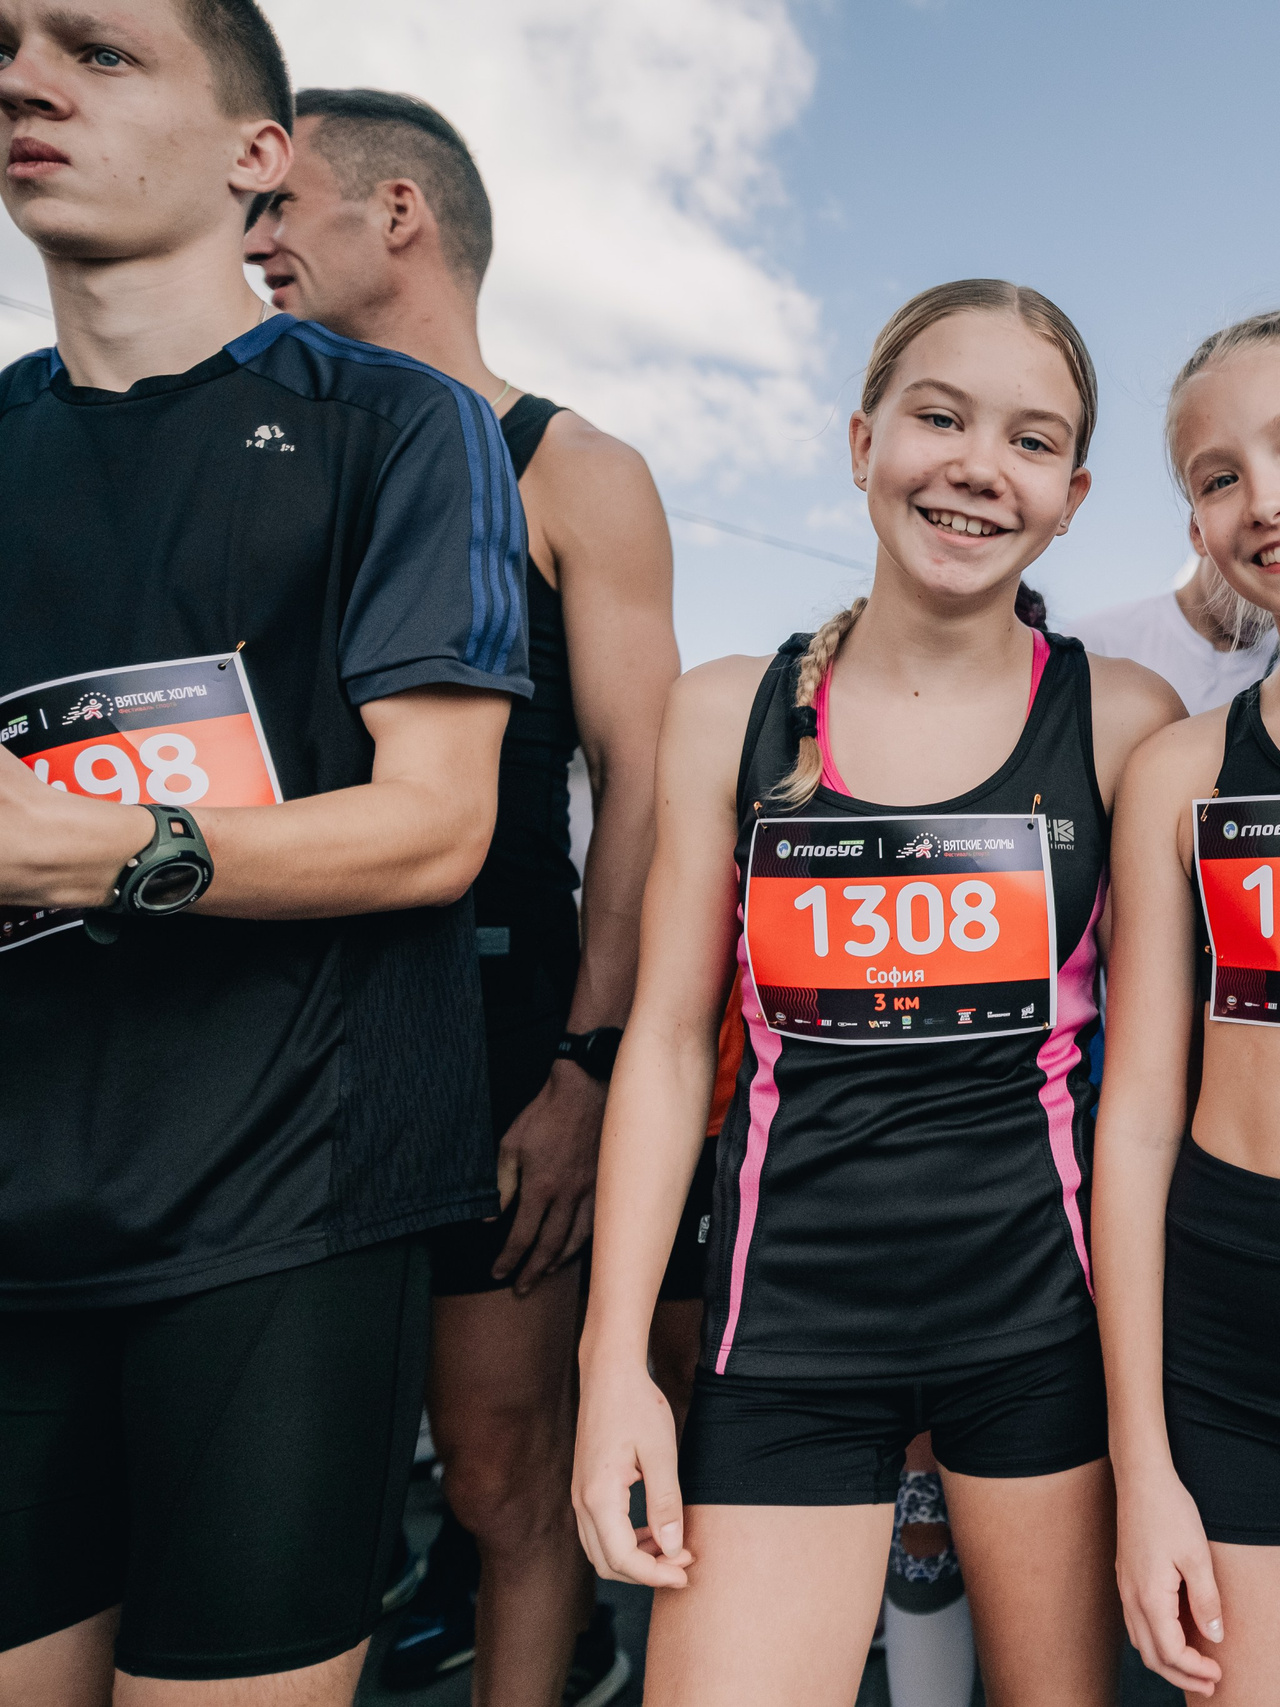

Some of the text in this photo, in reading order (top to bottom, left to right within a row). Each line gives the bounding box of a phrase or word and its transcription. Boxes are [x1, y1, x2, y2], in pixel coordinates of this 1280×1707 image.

[115, 685, 208, 708] ВЯТСКИЕ ХОЛМЫ
[0, 720, 29, 744] БУС
[793, 843, 864, 858] ГЛОБУС
[943, 838, 1015, 851] ВЯТСКИЕ ХОЛМЫ
[793, 880, 1000, 958] 1308
[866, 965, 925, 987] София
[873, 993, 920, 1012] 3 км
